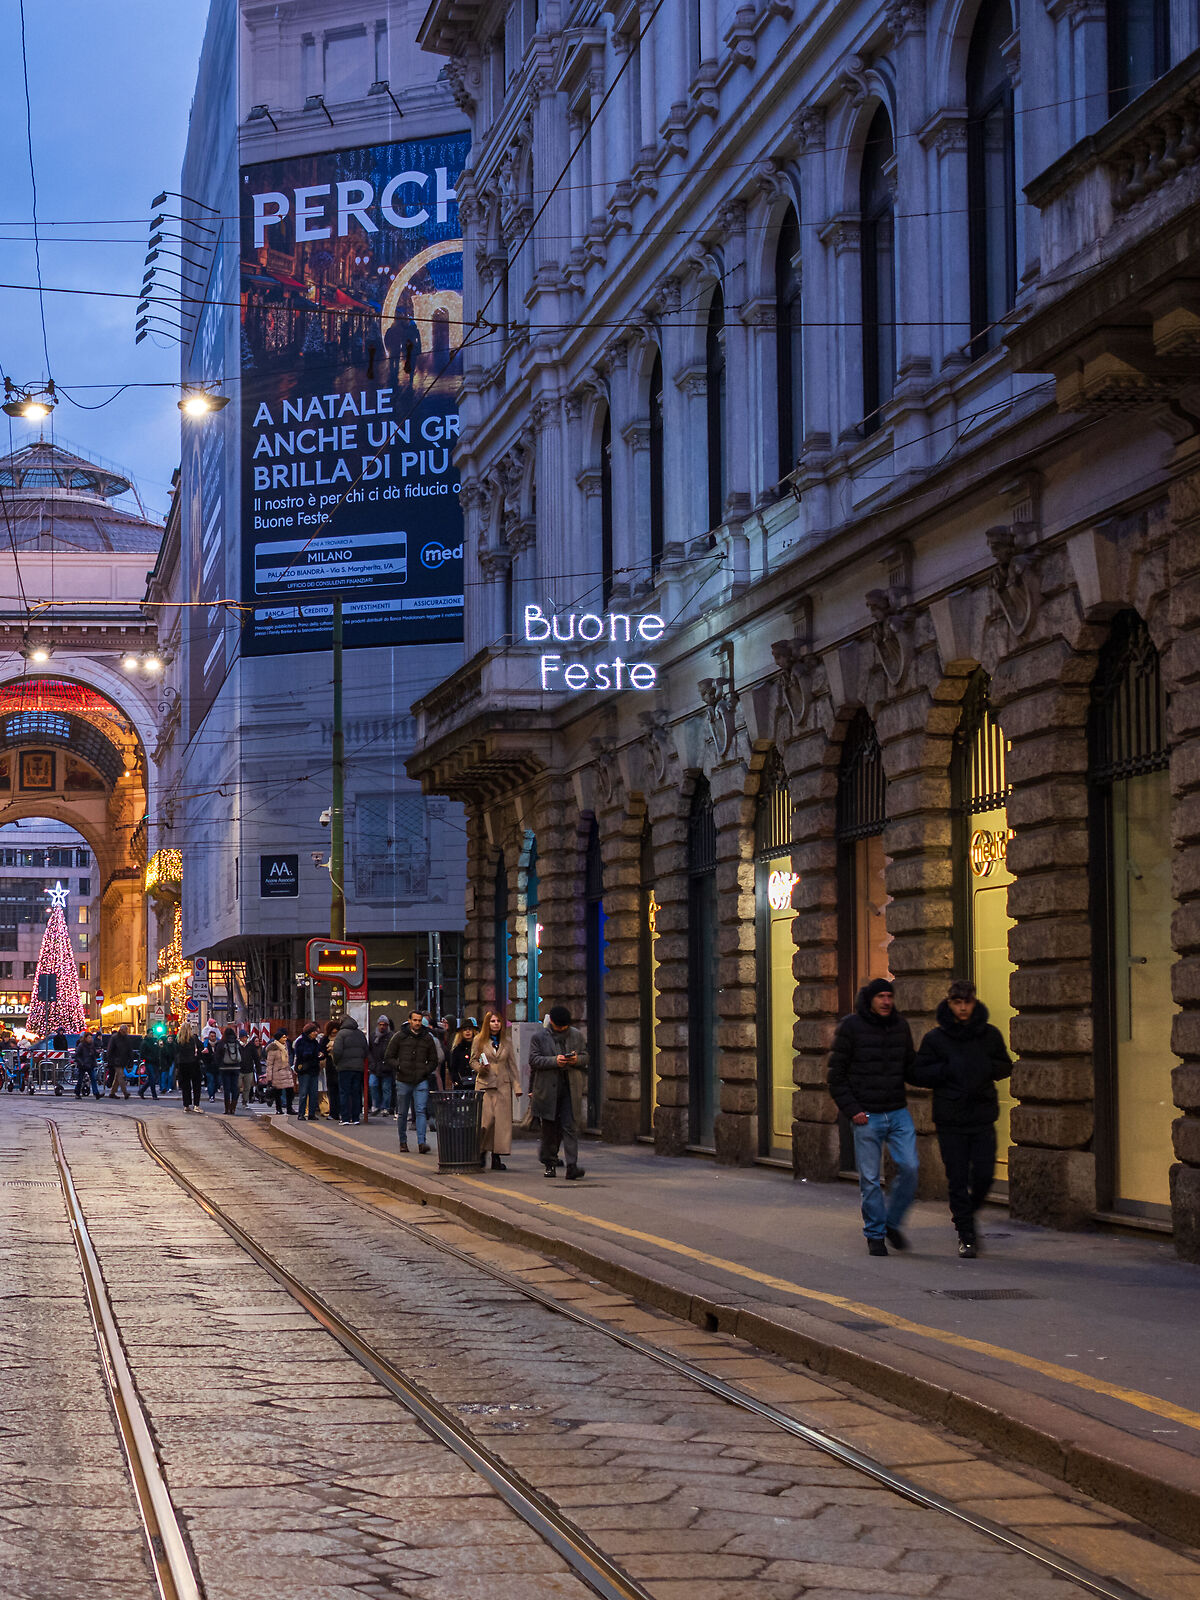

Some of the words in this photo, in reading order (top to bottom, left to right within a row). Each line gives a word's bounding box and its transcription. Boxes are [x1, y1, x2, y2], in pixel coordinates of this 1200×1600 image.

[253, 402, 274, 428] A
[282, 388, 394, 424] NATALE
[252, 425, 358, 459] ANCHE
[367, 419, 411, 448] UN
[254, 458, 352, 491] BRILLA
[362, 454, 390, 481] DI
[401, 442, 449, 477] PIÙ
[254, 498, 261, 512] Il
[265, 495, 304, 510] nostro
[308, 492, 316, 506] è
[320, 492, 342, 509] per
[346, 487, 365, 503] chi
[368, 488, 379, 501] ci
[383, 484, 400, 500] dà
[404, 481, 448, 498] fiducia
[254, 514, 293, 530] Buone
[298, 511, 333, 525] Feste.
[307, 550, 353, 563] MILANO
[350, 603, 391, 611] INVESTIMENTI
[414, 598, 462, 607] ASSICURAZIONE
[524, 605, 666, 641] Buone
[541, 655, 657, 690] Feste
